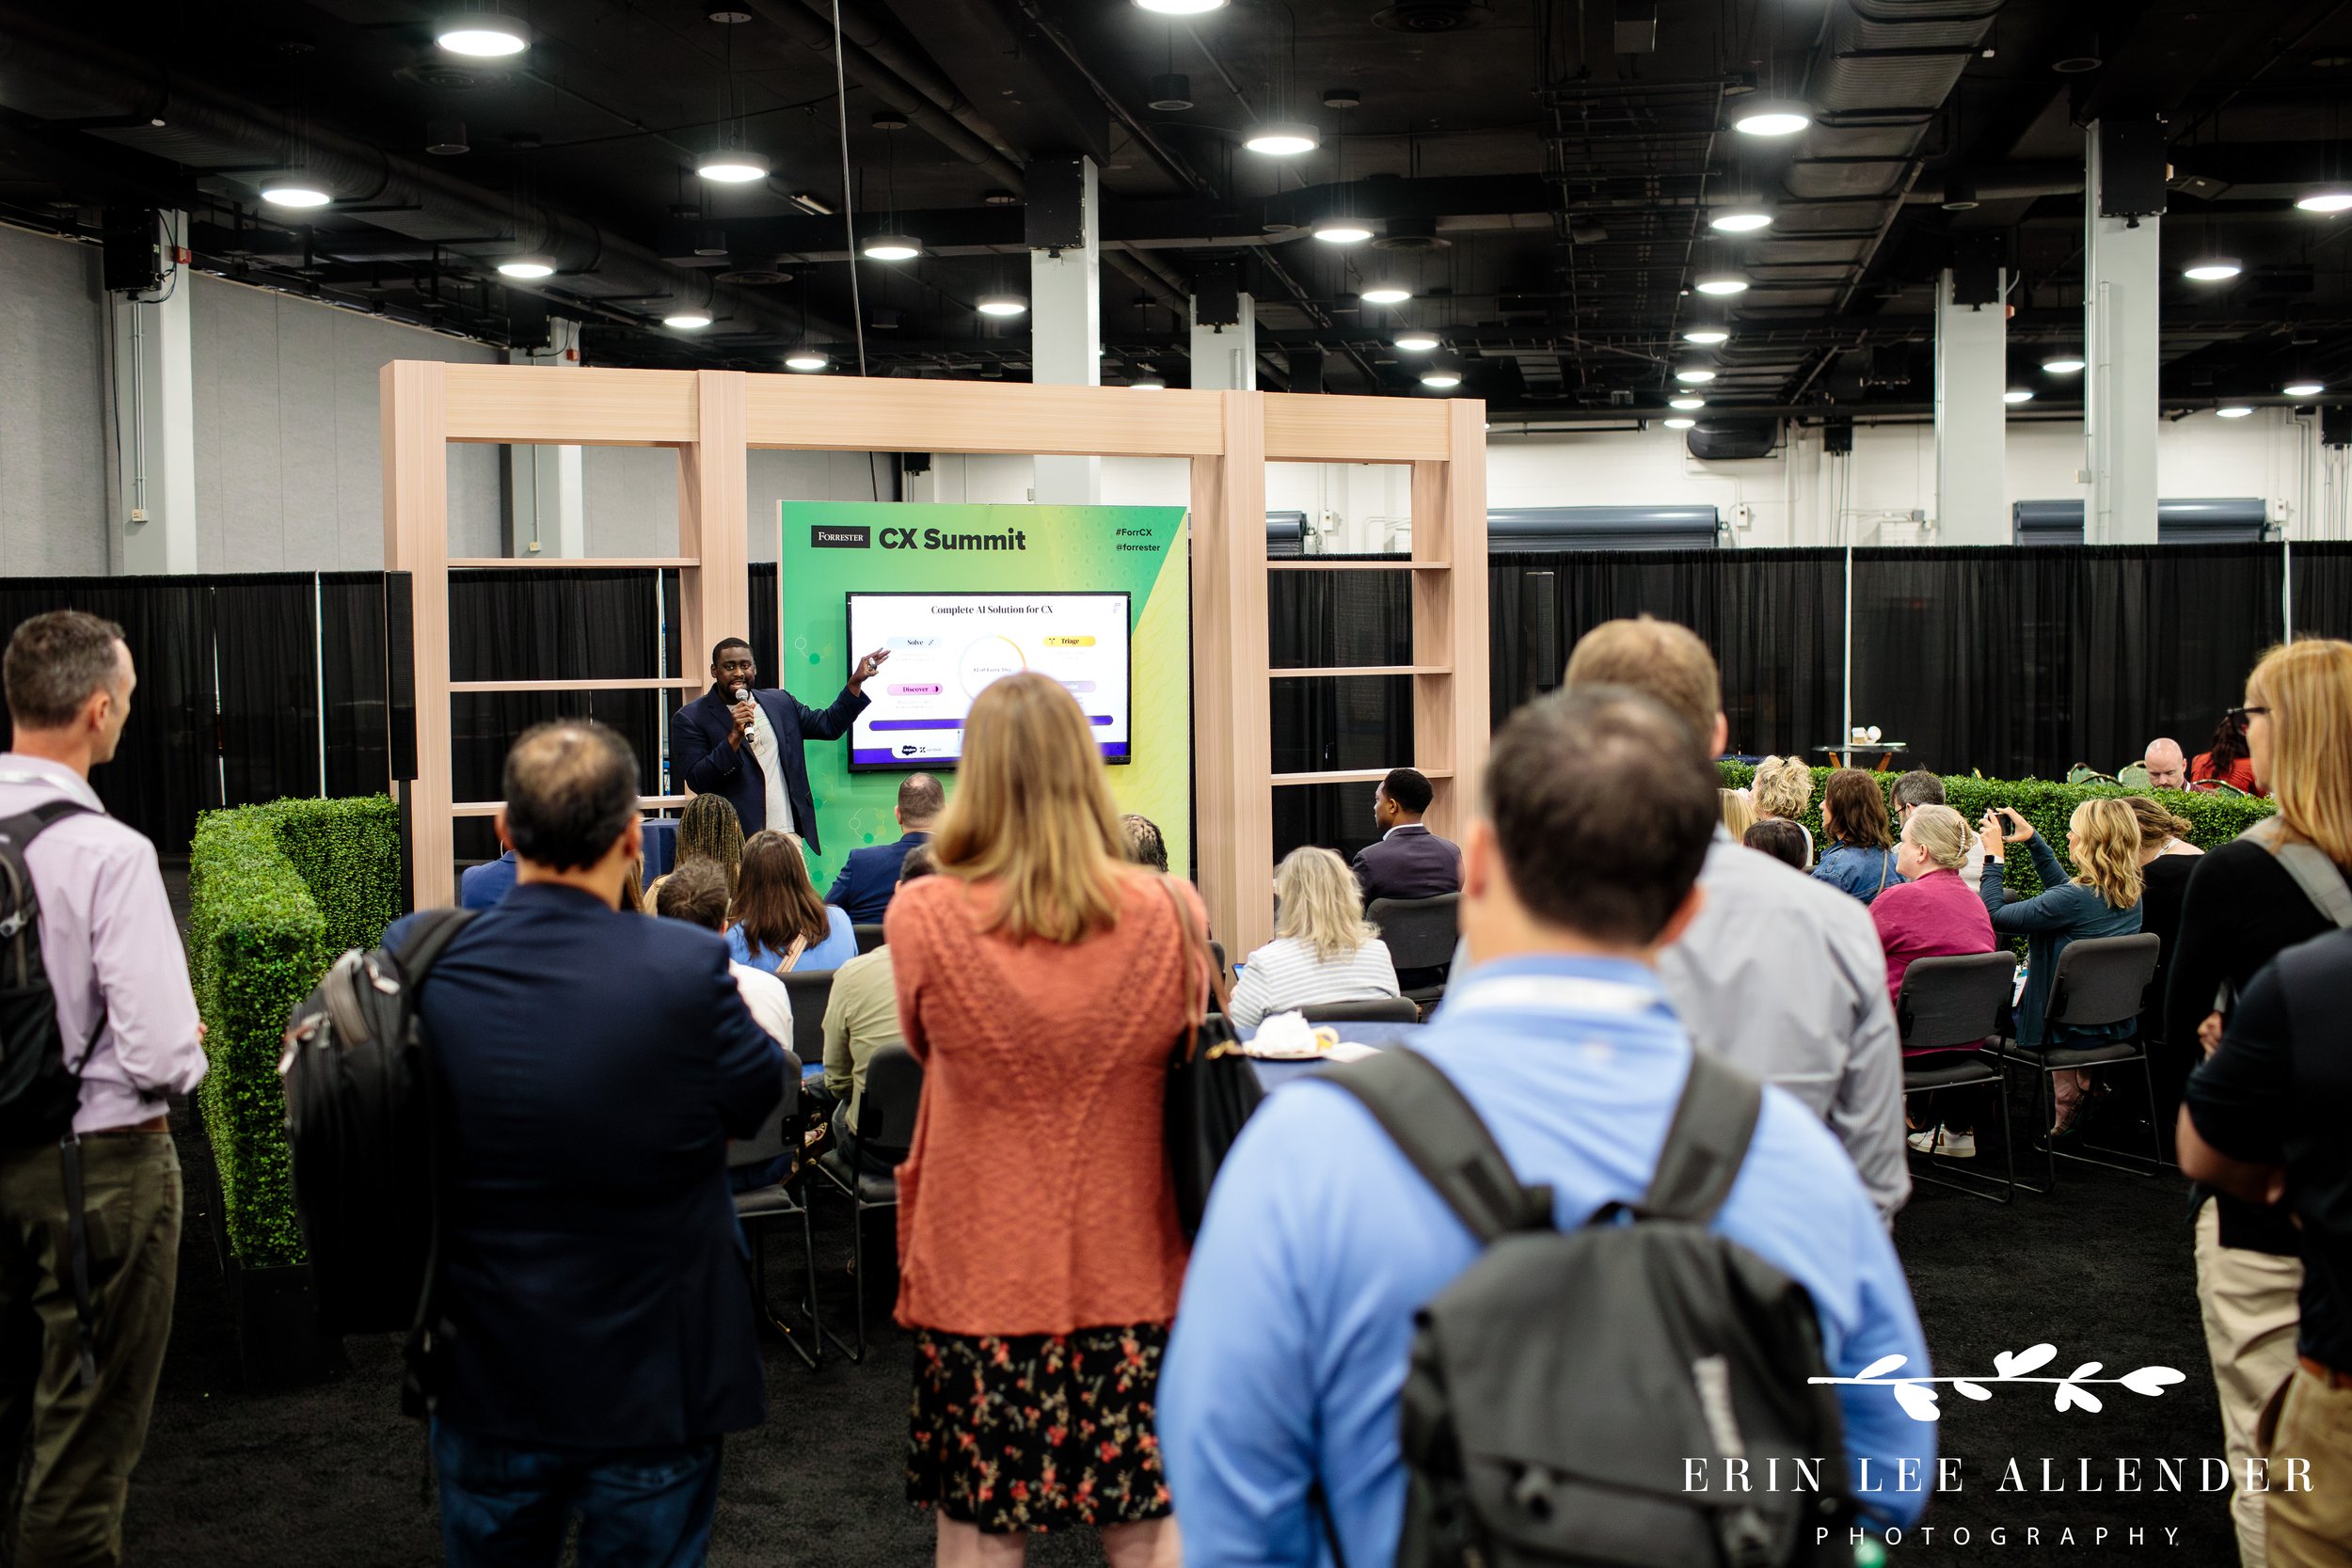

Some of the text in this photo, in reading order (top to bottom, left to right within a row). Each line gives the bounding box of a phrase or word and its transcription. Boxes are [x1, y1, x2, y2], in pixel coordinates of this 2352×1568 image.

[1116, 528, 1152, 536] #ForrCX
[818, 527, 1026, 550] FORRESTER CX Summit
[1116, 543, 1161, 552] @forrester
[930, 605, 1054, 616] Complete AI Solution for CX
